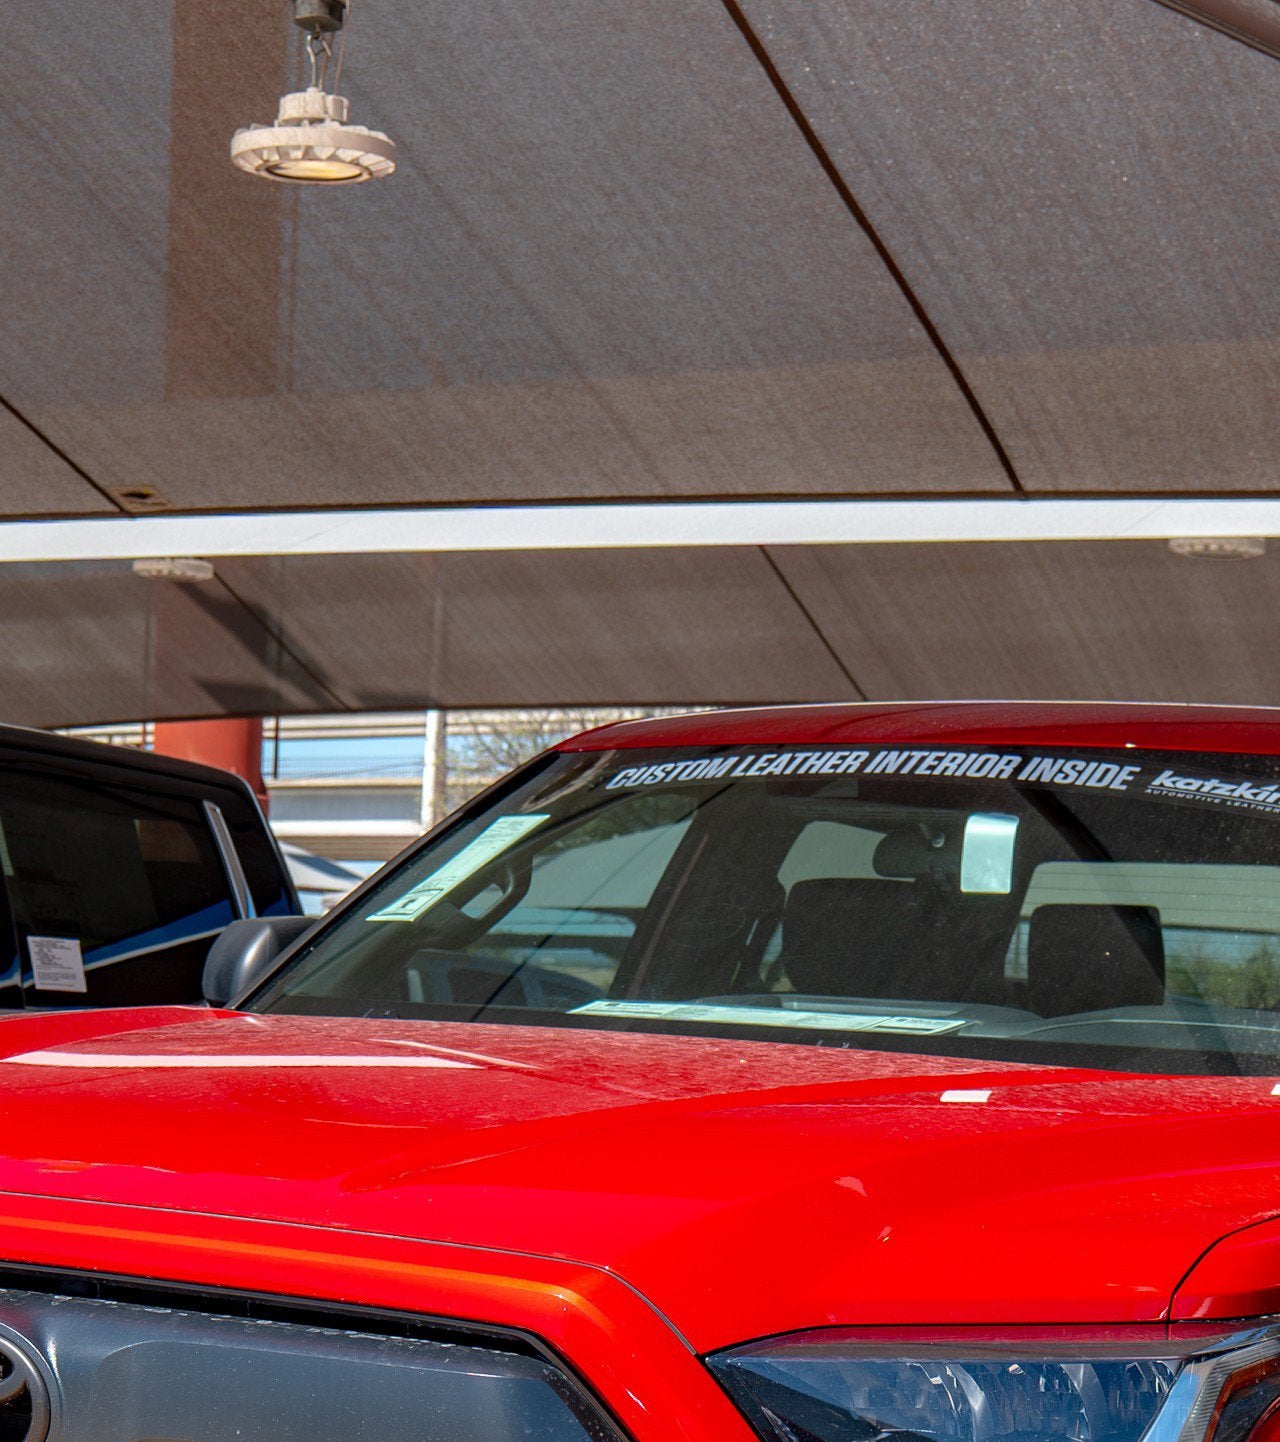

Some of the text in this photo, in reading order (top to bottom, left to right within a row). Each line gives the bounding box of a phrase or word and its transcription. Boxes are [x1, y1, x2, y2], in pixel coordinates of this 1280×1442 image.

[605, 750, 1141, 790] CUSTOM LEATHER INTERIOR INSIDE
[1144, 788, 1280, 814] AUTOMOTIVE LEATHER
